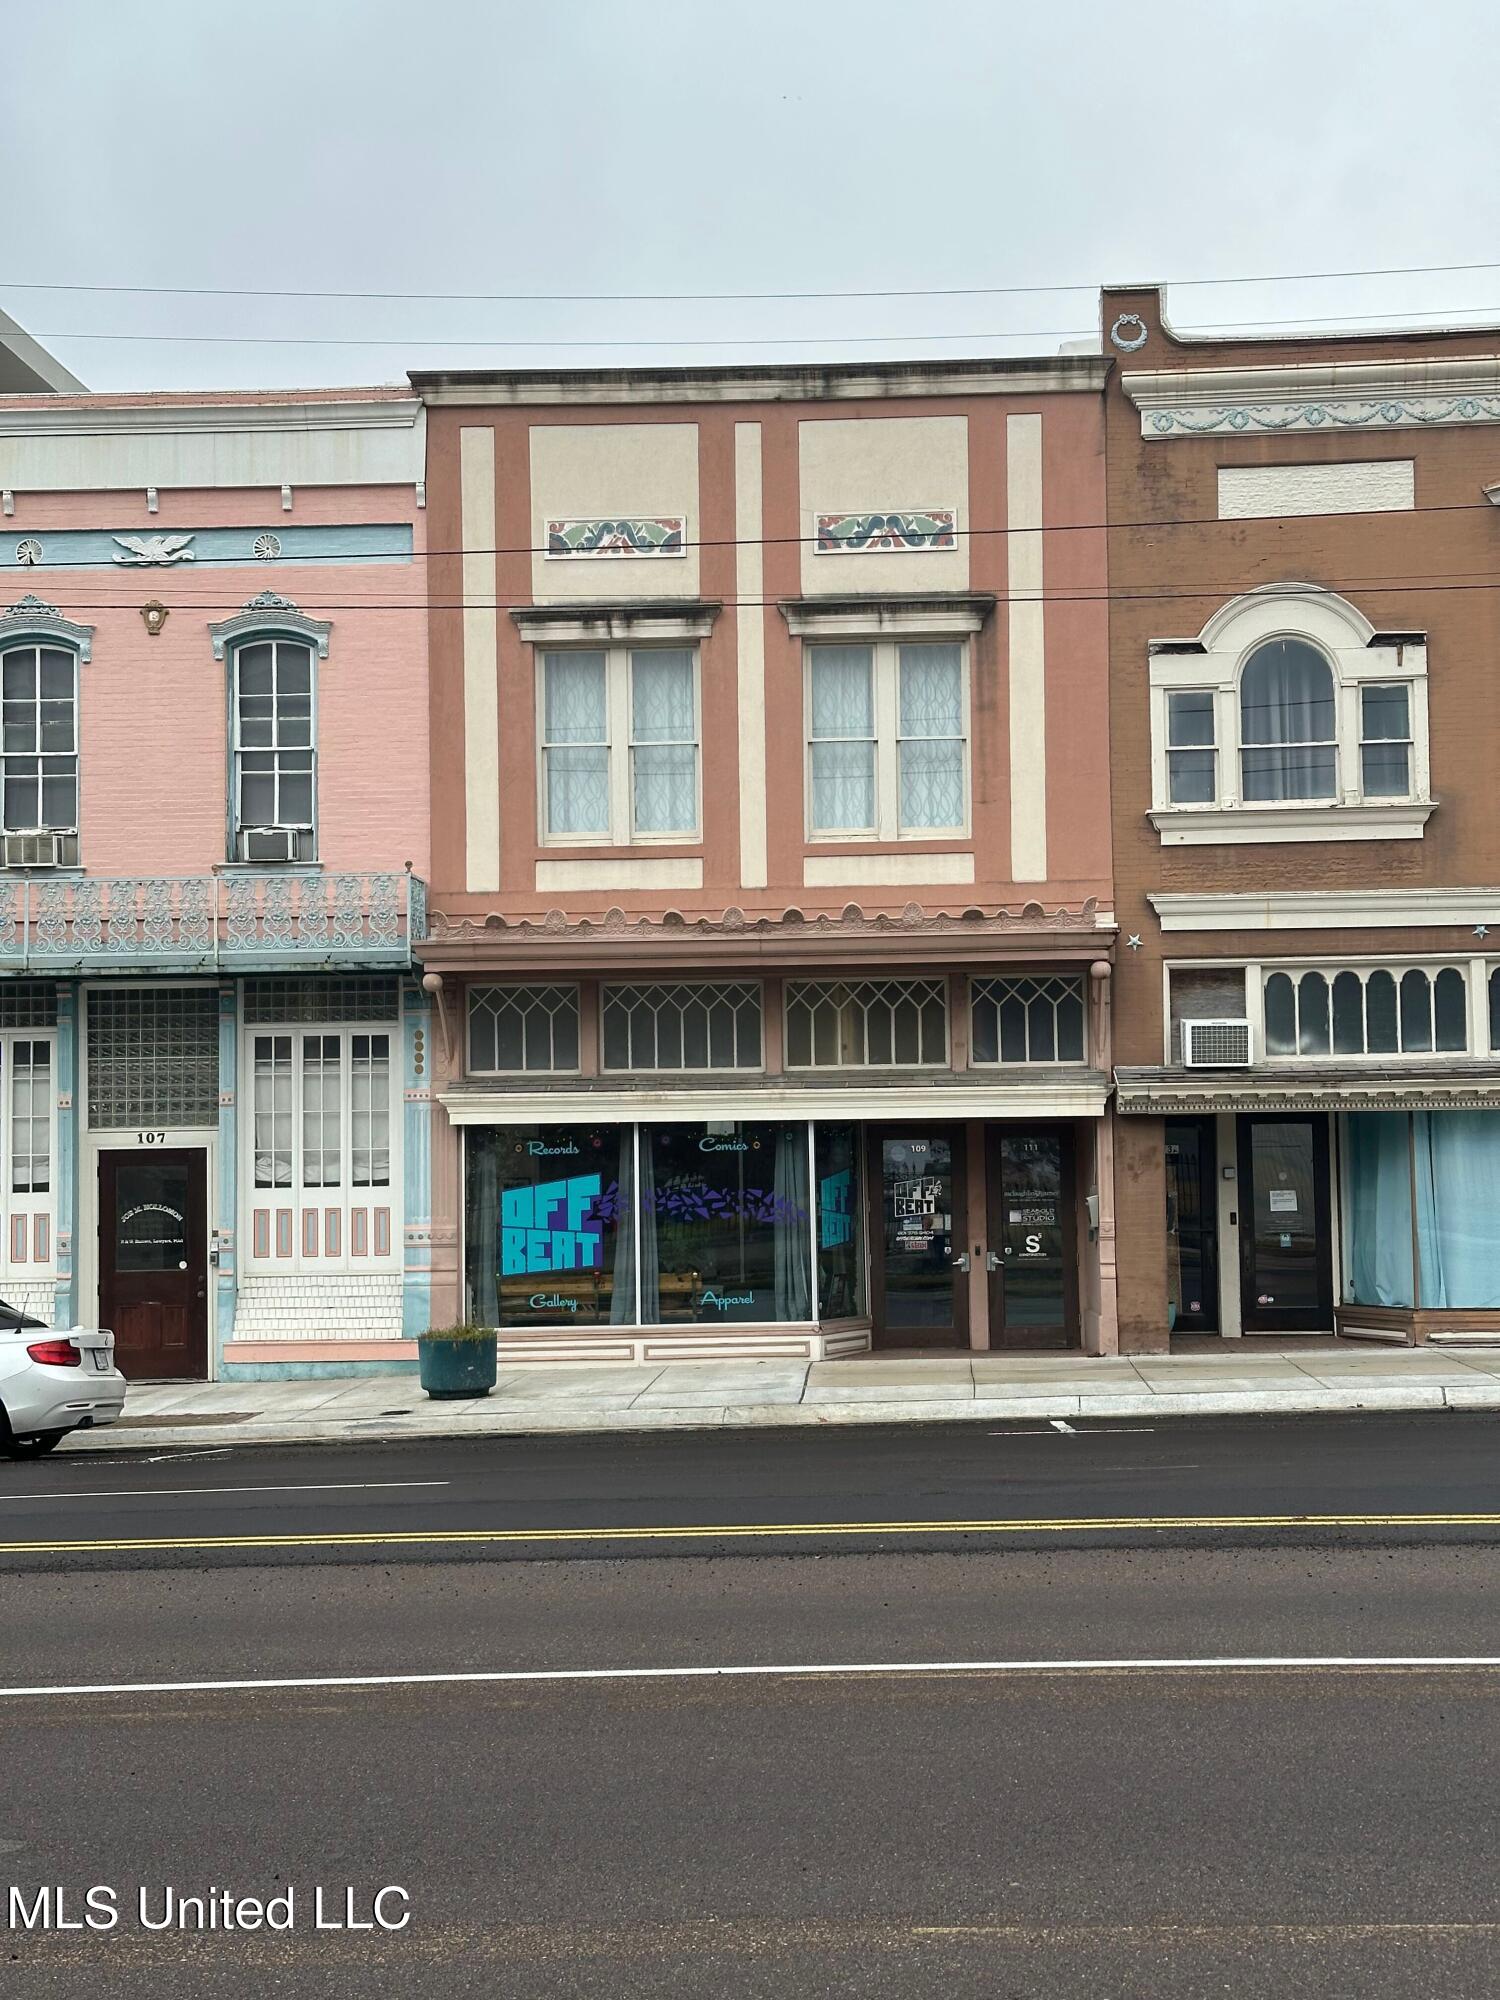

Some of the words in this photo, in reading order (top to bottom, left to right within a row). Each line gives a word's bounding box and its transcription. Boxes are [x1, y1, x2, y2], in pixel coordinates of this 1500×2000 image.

[137, 1132, 165, 1144] 107
[699, 1137, 749, 1152] Comics
[527, 1140, 579, 1156] Records
[911, 1145, 926, 1153] 109
[502, 1174, 601, 1231] OFF
[896, 1198, 935, 1217] BEAT
[502, 1226, 600, 1276] BEAT
[530, 1293, 577, 1313] Gallery
[700, 1290, 755, 1311] Apparel
